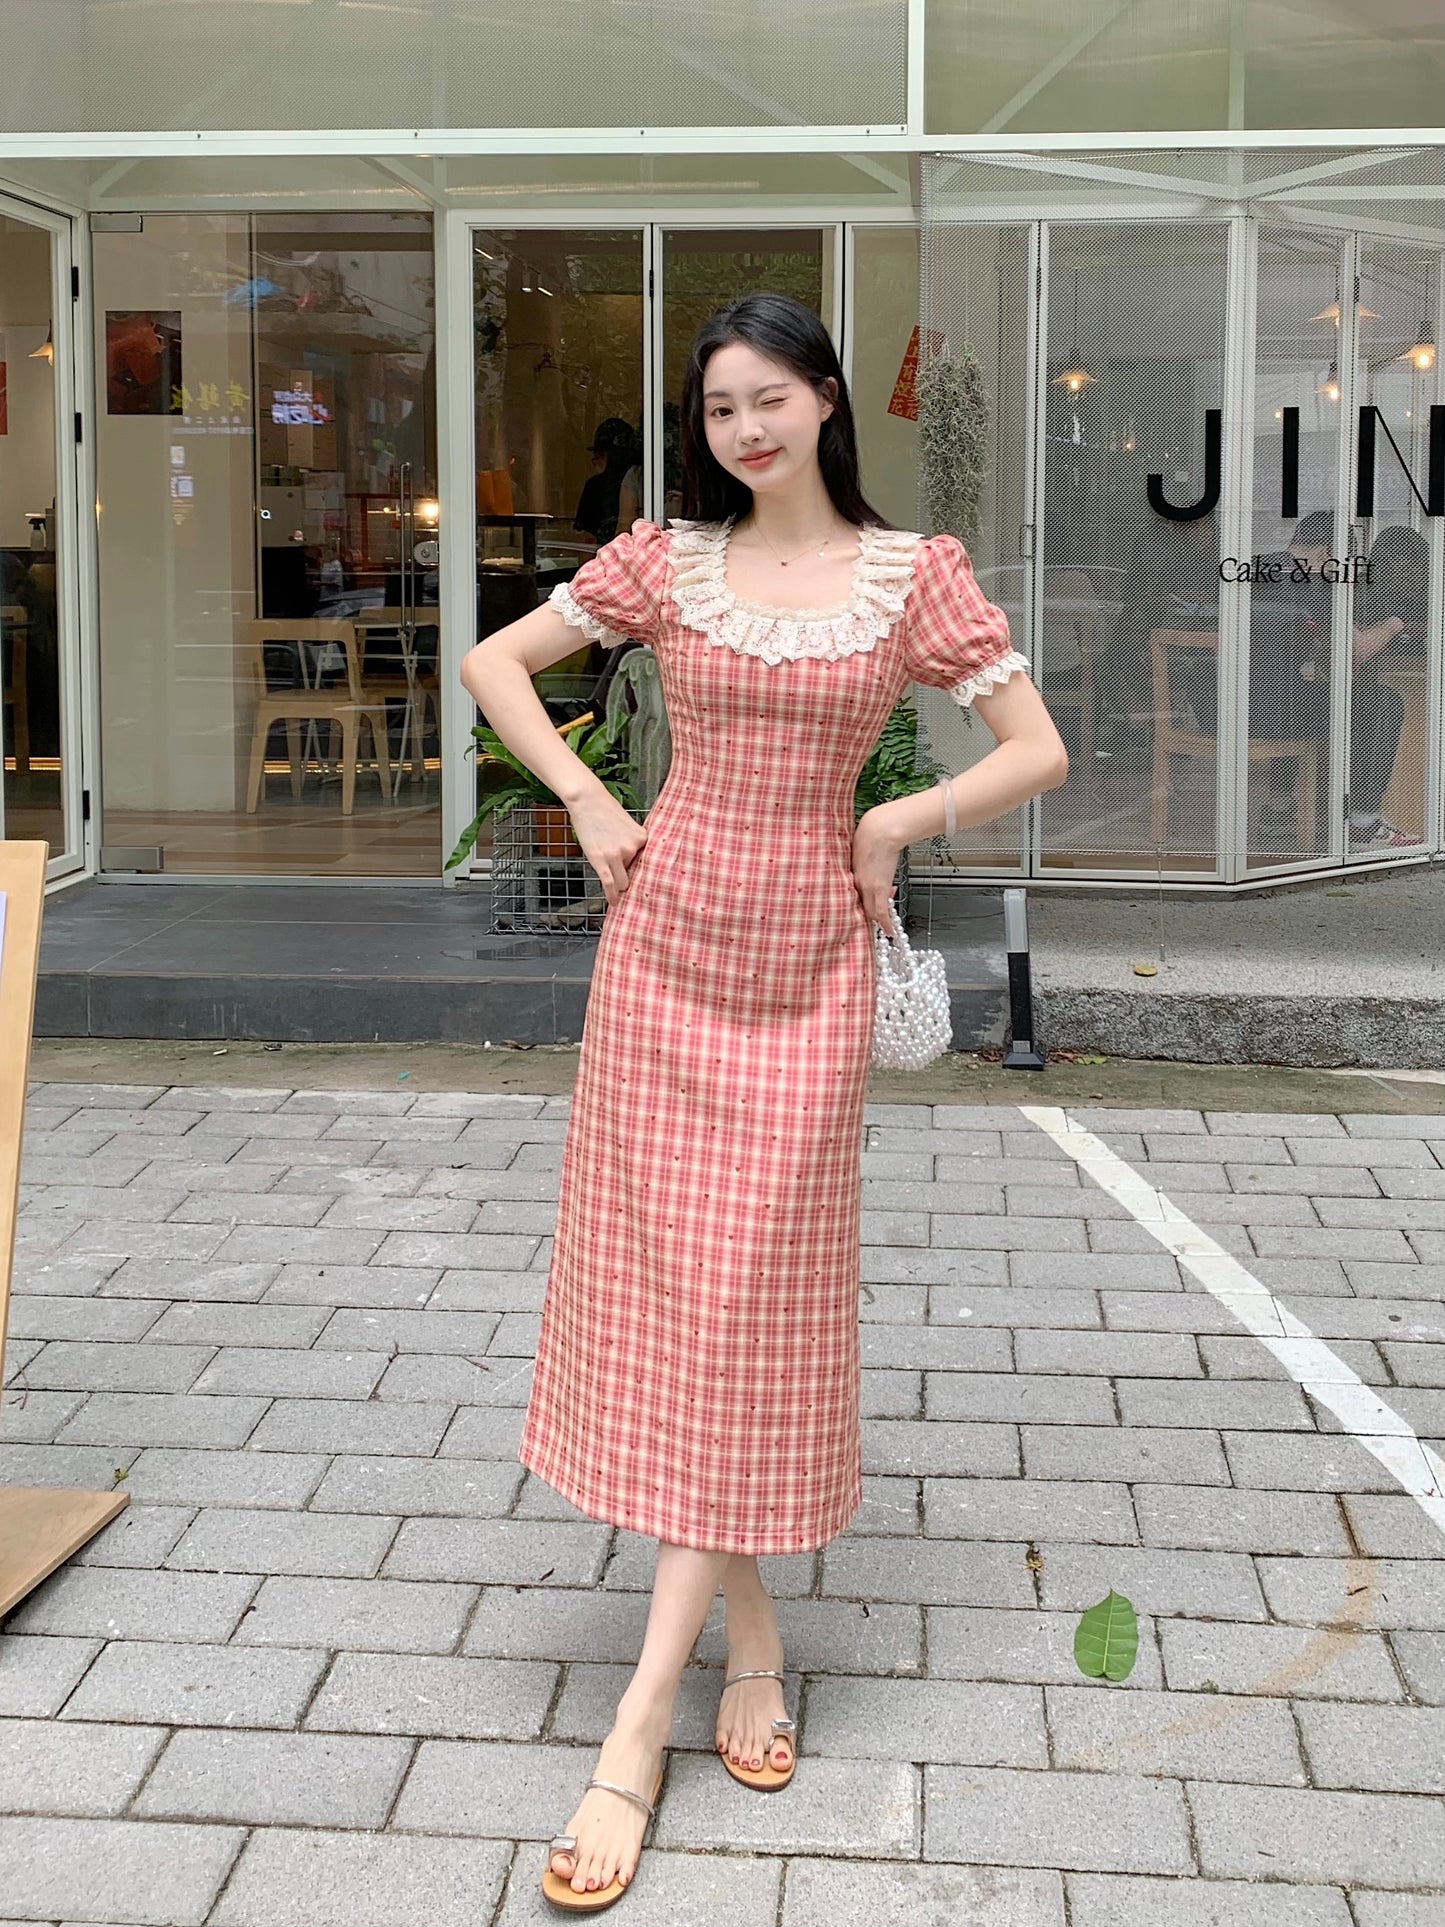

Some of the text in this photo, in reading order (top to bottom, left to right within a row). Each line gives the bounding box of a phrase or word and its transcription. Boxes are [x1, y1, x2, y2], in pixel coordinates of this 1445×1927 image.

[1147, 405, 1445, 521] JIN
[1219, 556, 1376, 584] Cake & Gift
